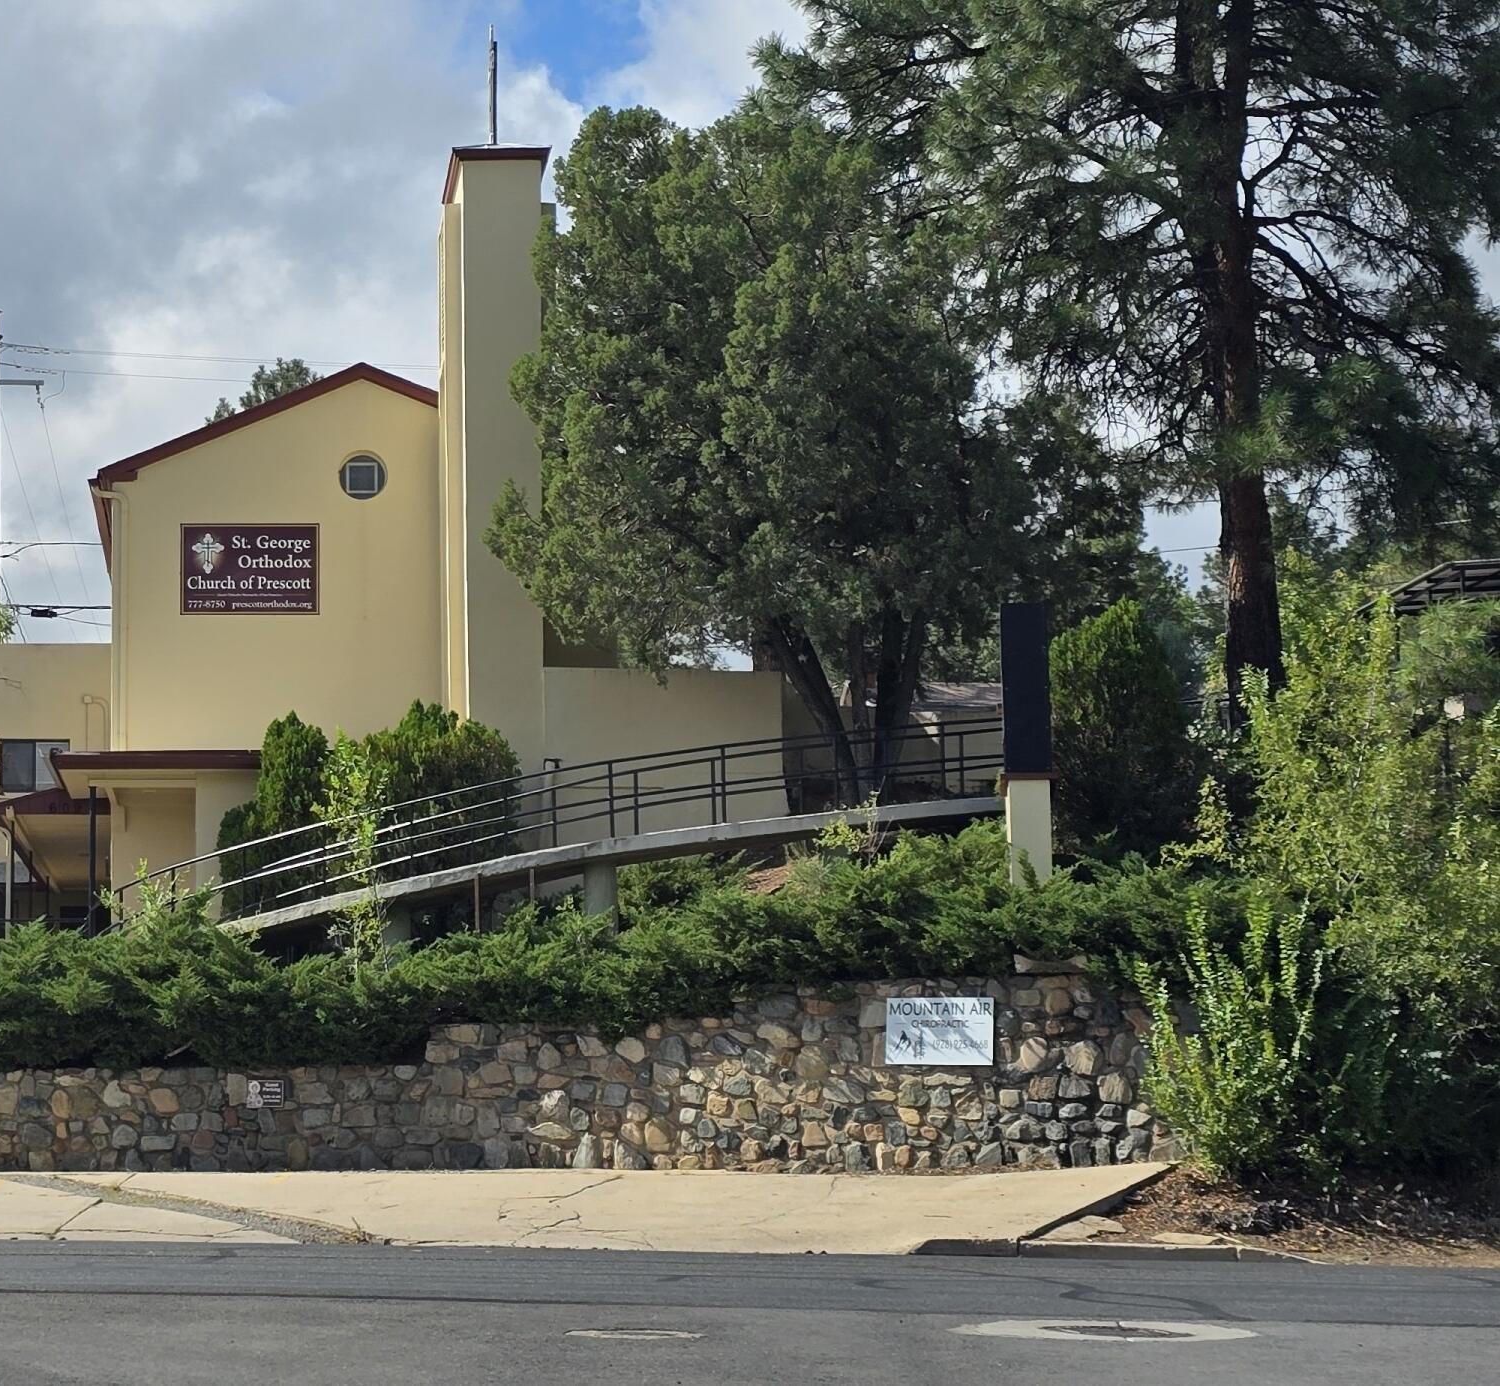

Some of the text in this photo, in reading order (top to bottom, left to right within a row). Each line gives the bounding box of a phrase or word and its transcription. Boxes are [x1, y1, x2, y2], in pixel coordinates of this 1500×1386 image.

[231, 535, 312, 553] St. George
[237, 554, 312, 569] Orthodox
[187, 575, 312, 589] Church of Prescott
[187, 599, 313, 609] 777-8750 prescottorthodox.org
[889, 1002, 992, 1016] MOUNTAIN AIR
[911, 1019, 969, 1028] CHIROPRACTIC
